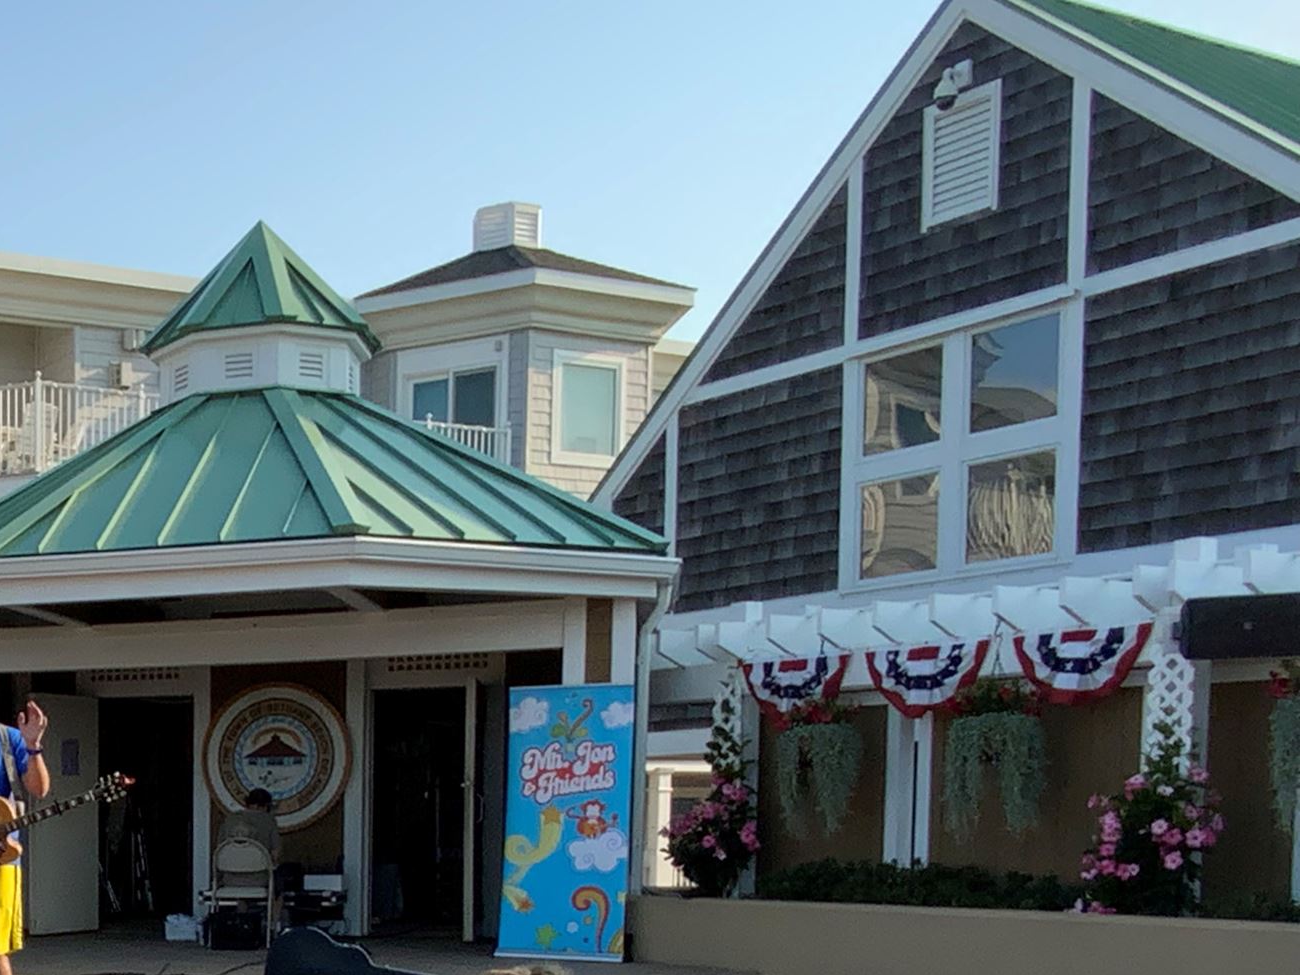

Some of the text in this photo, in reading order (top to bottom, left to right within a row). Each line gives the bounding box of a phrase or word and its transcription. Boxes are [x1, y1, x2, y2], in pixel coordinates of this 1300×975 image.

[521, 741, 616, 780] Mr. Jon
[523, 764, 615, 804] & Friends
